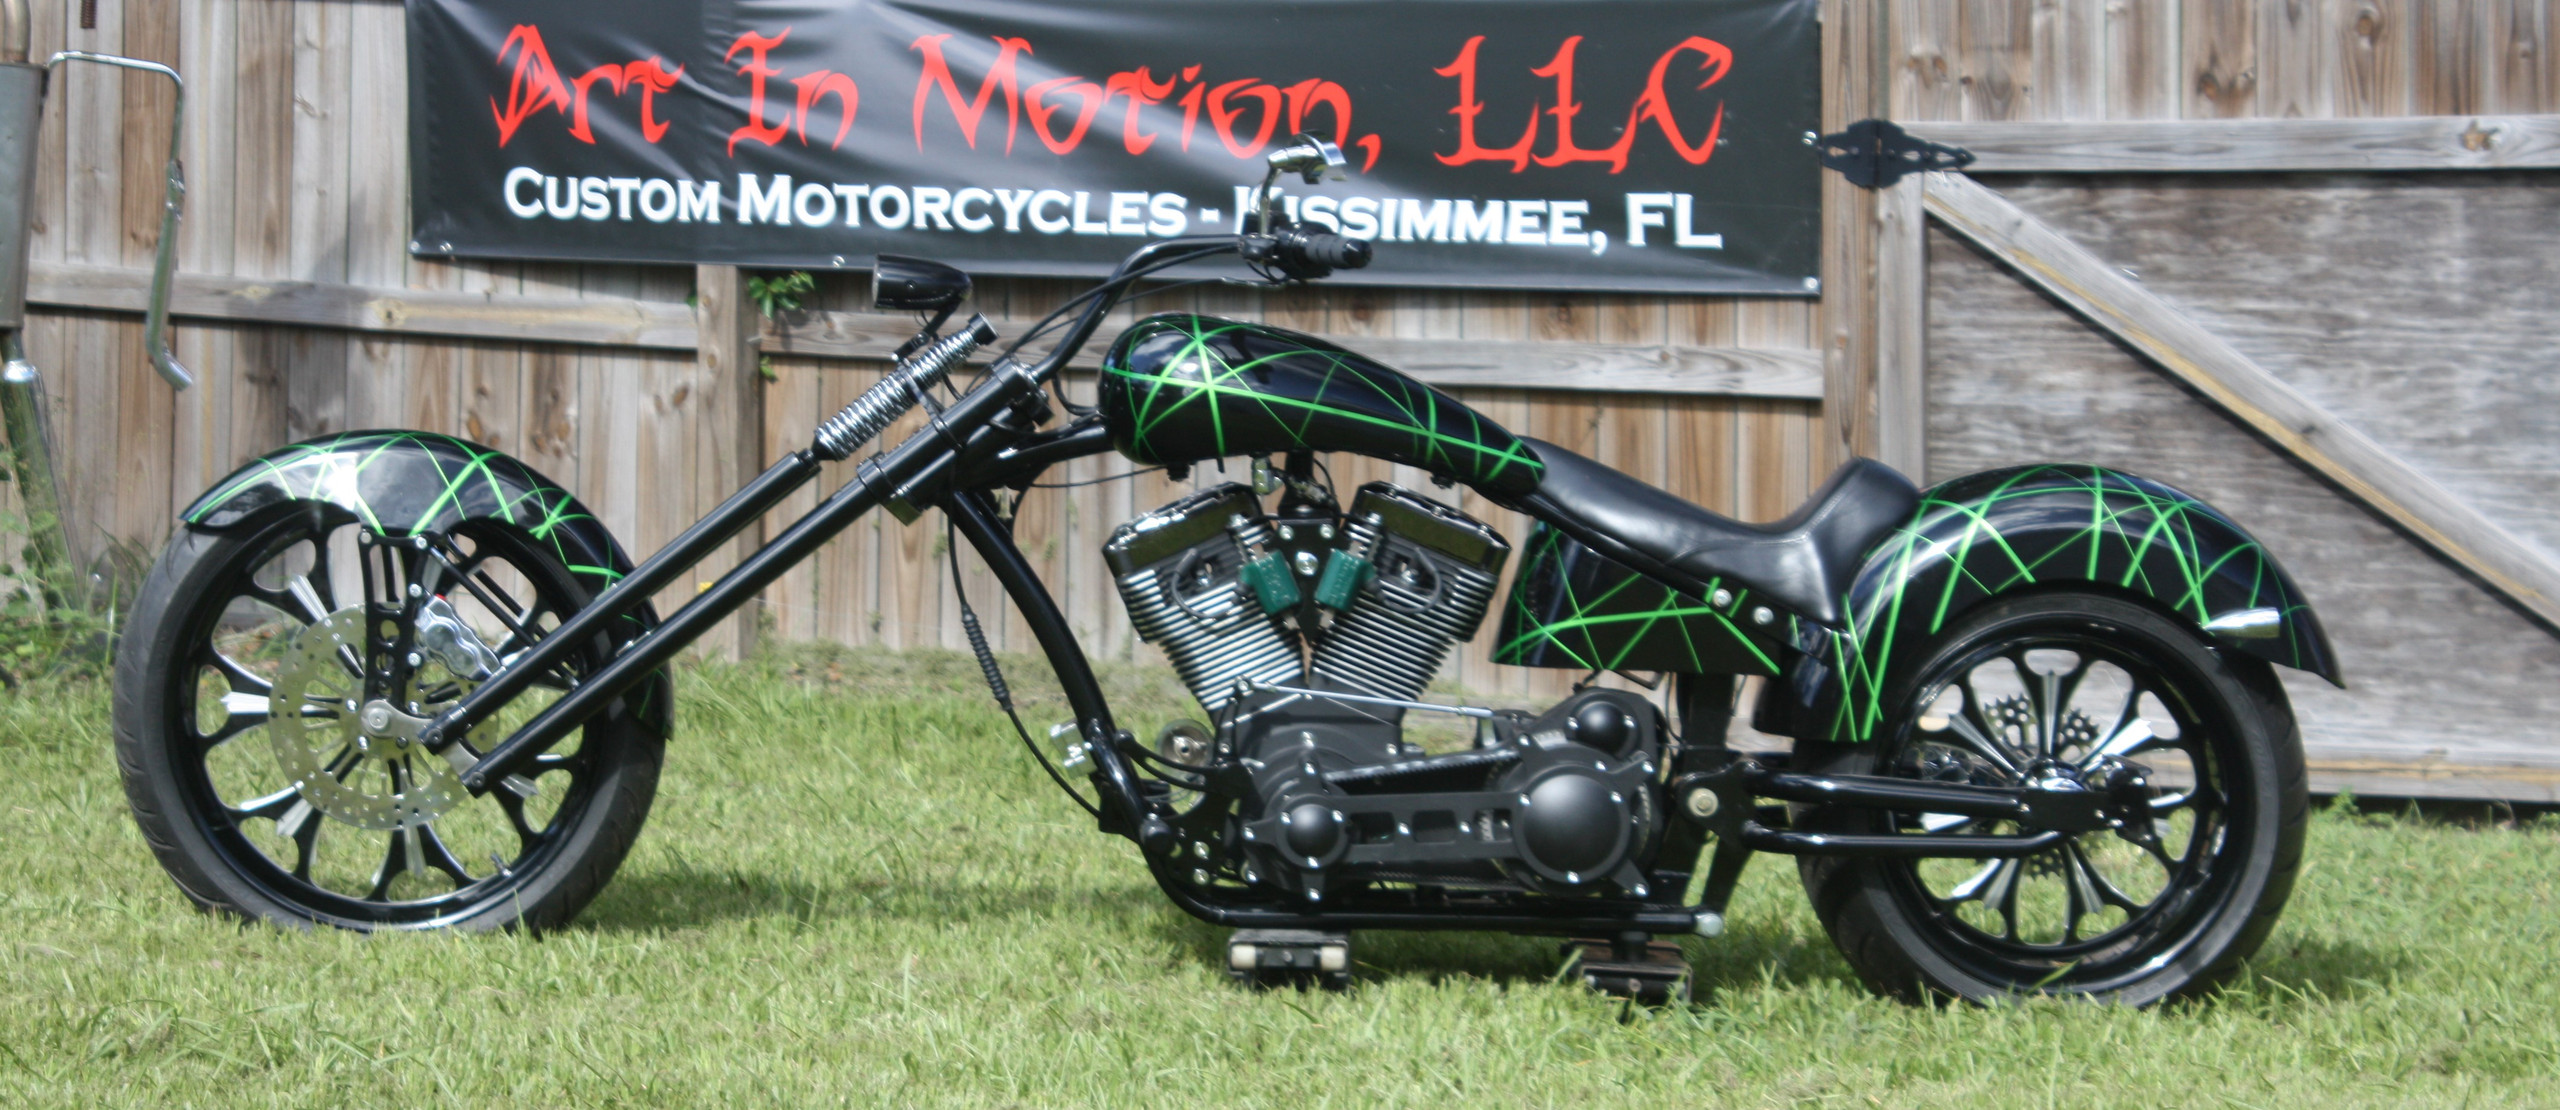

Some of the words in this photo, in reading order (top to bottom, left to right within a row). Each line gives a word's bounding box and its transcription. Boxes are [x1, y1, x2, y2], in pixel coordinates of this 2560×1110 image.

[490, 24, 685, 148] Art
[724, 26, 859, 158] In
[909, 33, 1383, 174] Motion,
[1432, 35, 1734, 175] LLC
[504, 166, 721, 223] CUSTOM
[737, 173, 1188, 238] MOTORCYCLES
[1626, 192, 1723, 250] FL
